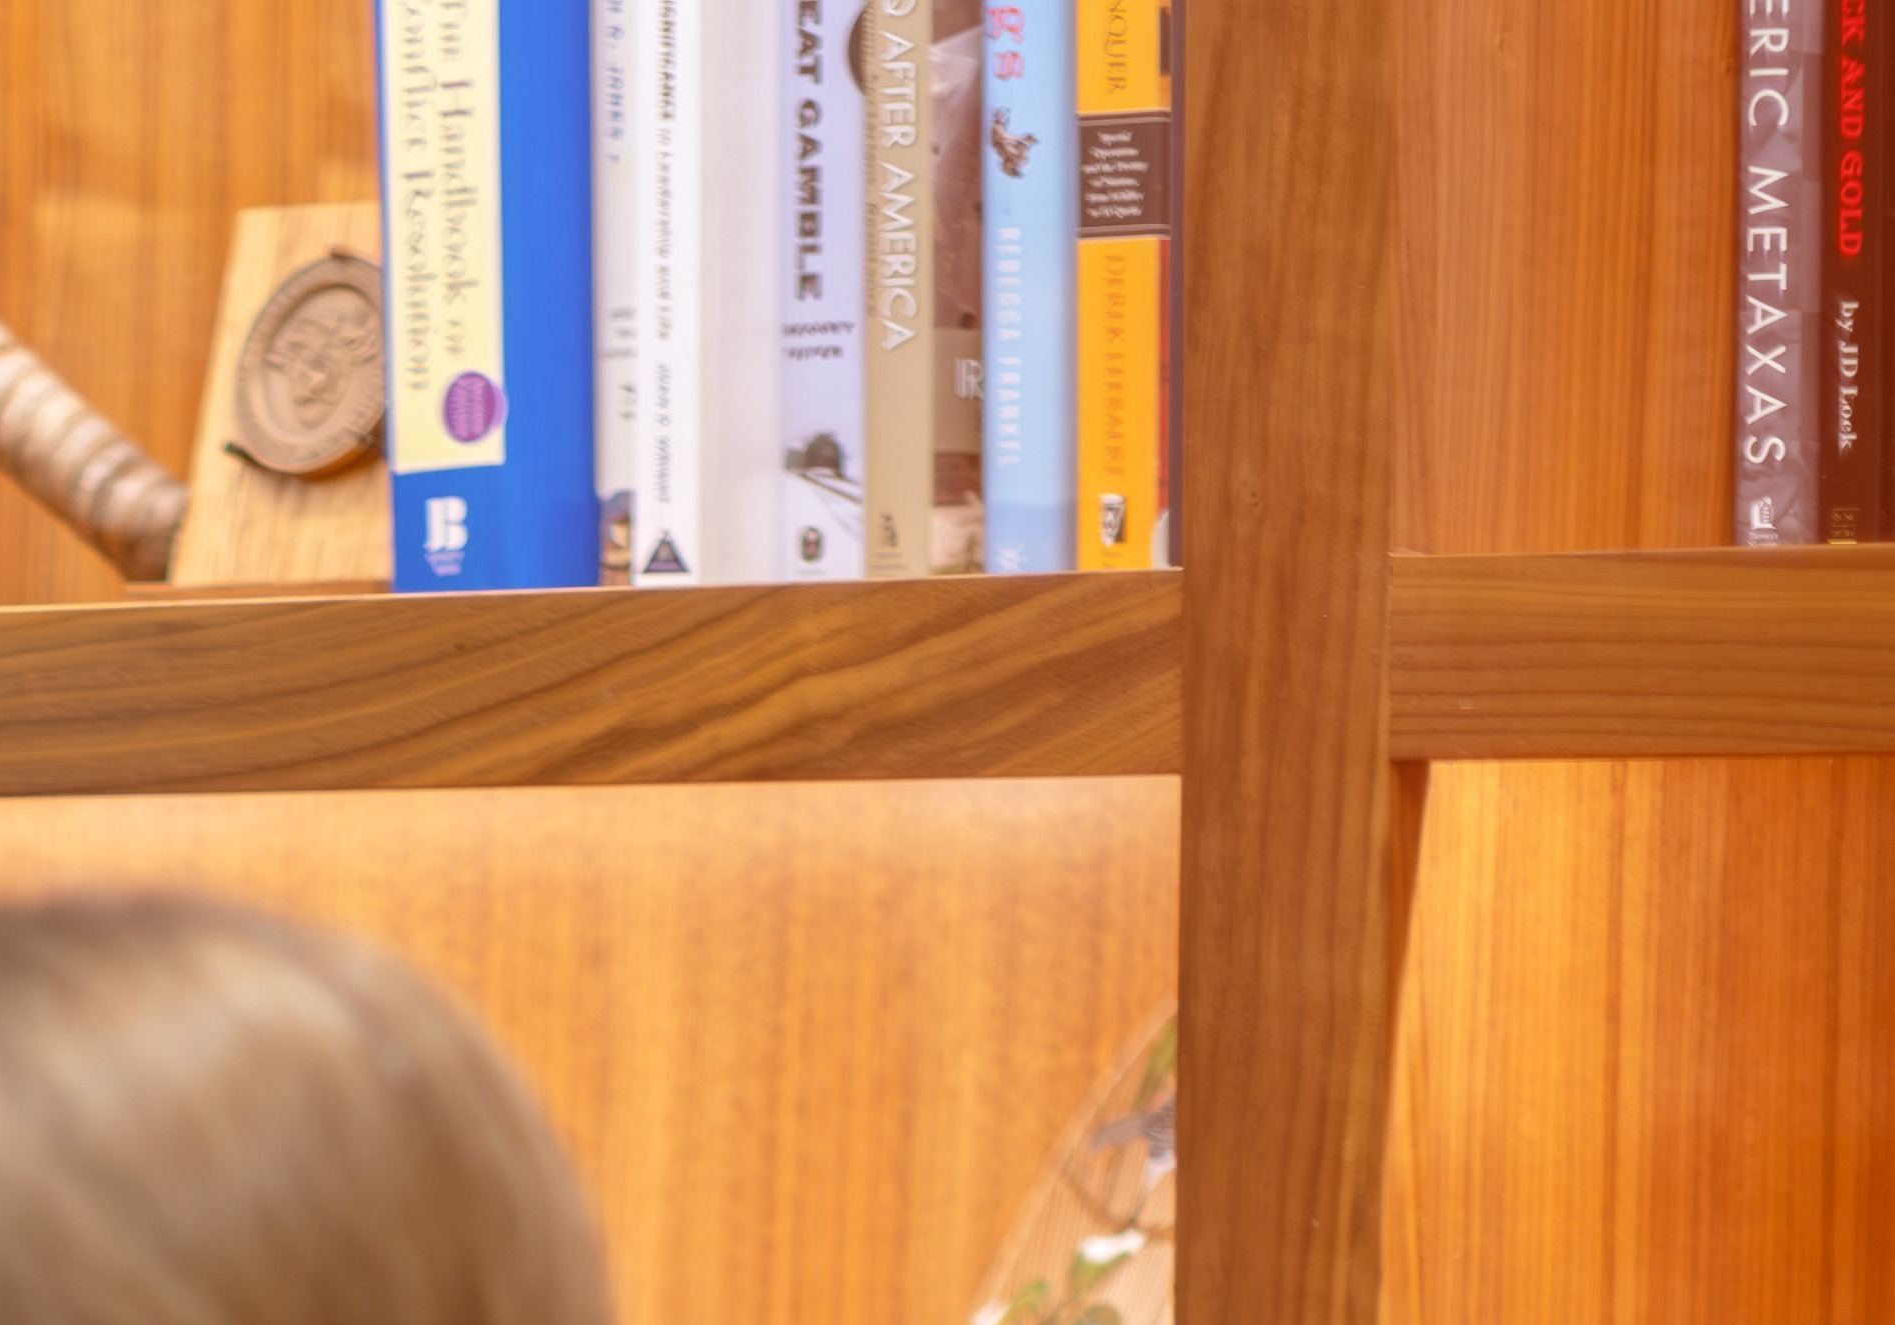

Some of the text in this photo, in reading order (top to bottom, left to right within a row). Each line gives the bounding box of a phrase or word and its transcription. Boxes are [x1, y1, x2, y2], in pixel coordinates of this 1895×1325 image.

[438, 79, 479, 304] Handbook
[797, 0, 823, 301] EAT GAMBLE
[879, 30, 917, 149] AFTER
[1839, 56, 1865, 139] AND
[401, 0, 439, 392] onflict Resolution
[879, 161, 918, 352] AMERICA
[1838, 150, 1864, 257] GOLD
[996, 227, 1022, 466] REBECCA FRANKEL
[1746, 165, 1789, 465] METAXAS
[1835, 300, 1859, 452] by JD Lock
